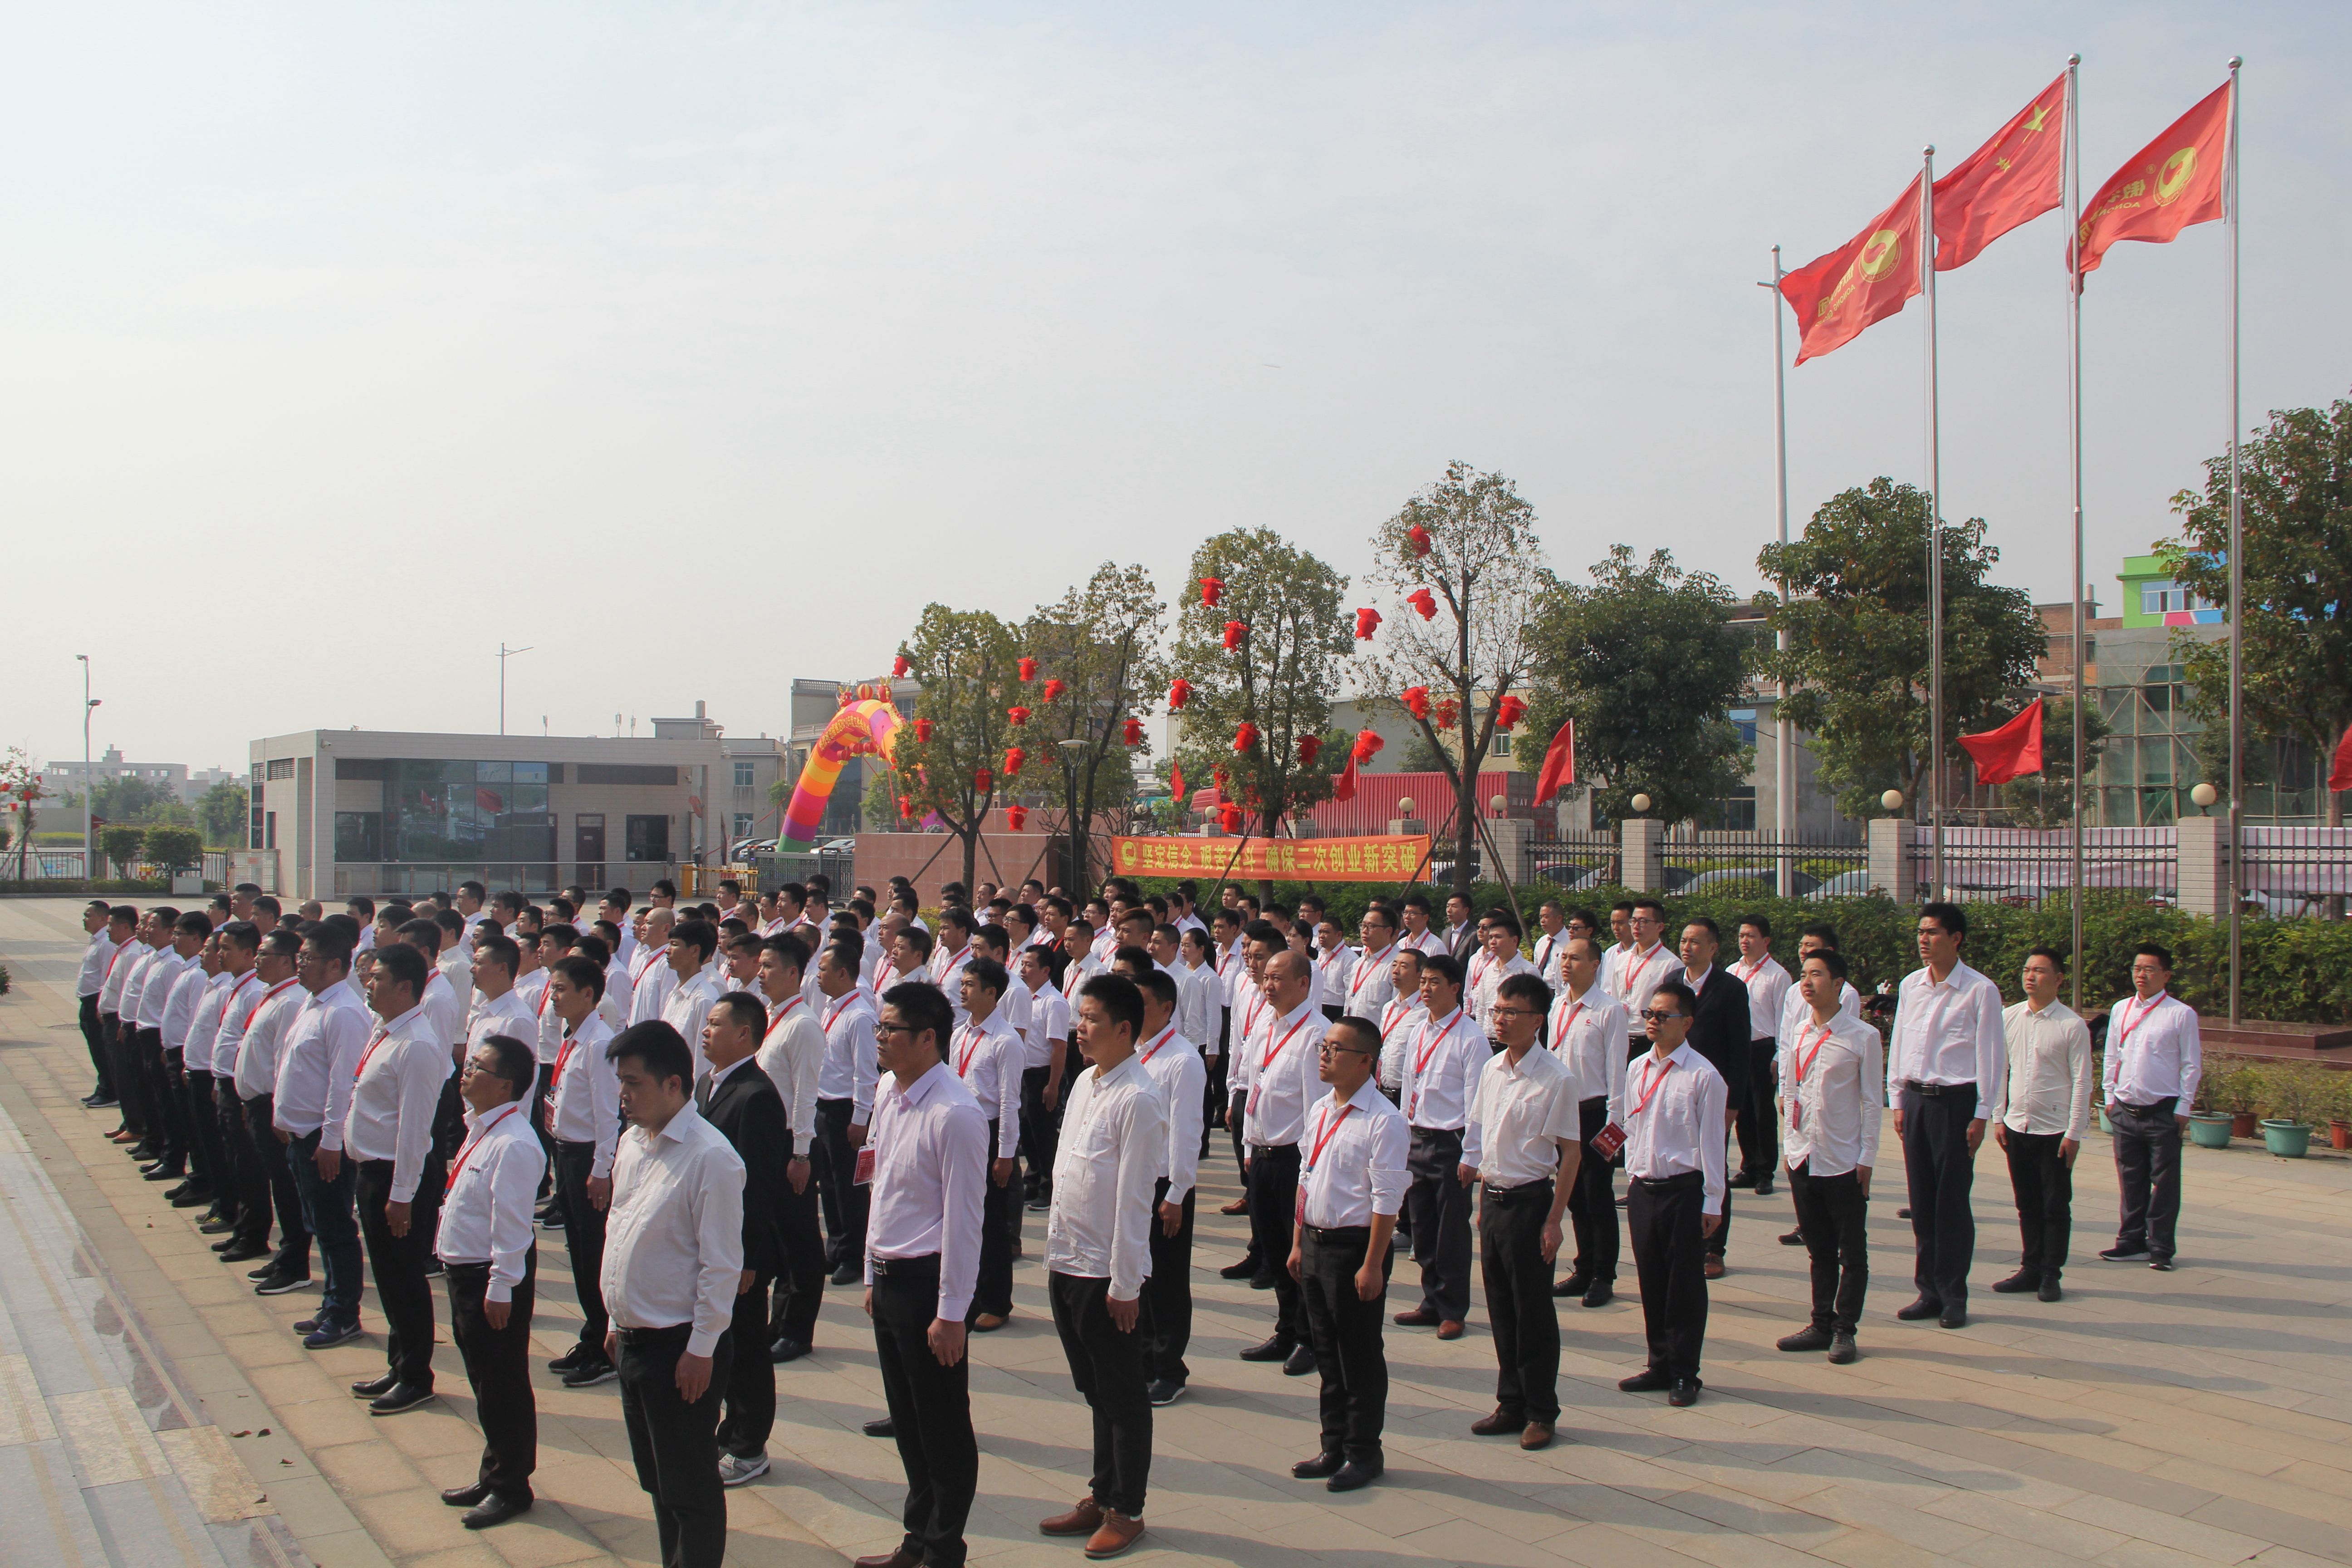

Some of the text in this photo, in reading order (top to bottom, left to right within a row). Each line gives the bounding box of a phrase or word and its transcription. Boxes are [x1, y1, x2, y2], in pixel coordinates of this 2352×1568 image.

[1143, 842, 1417, 873] 坚定信念 艰苦奋斗 确保二次创业新突破
